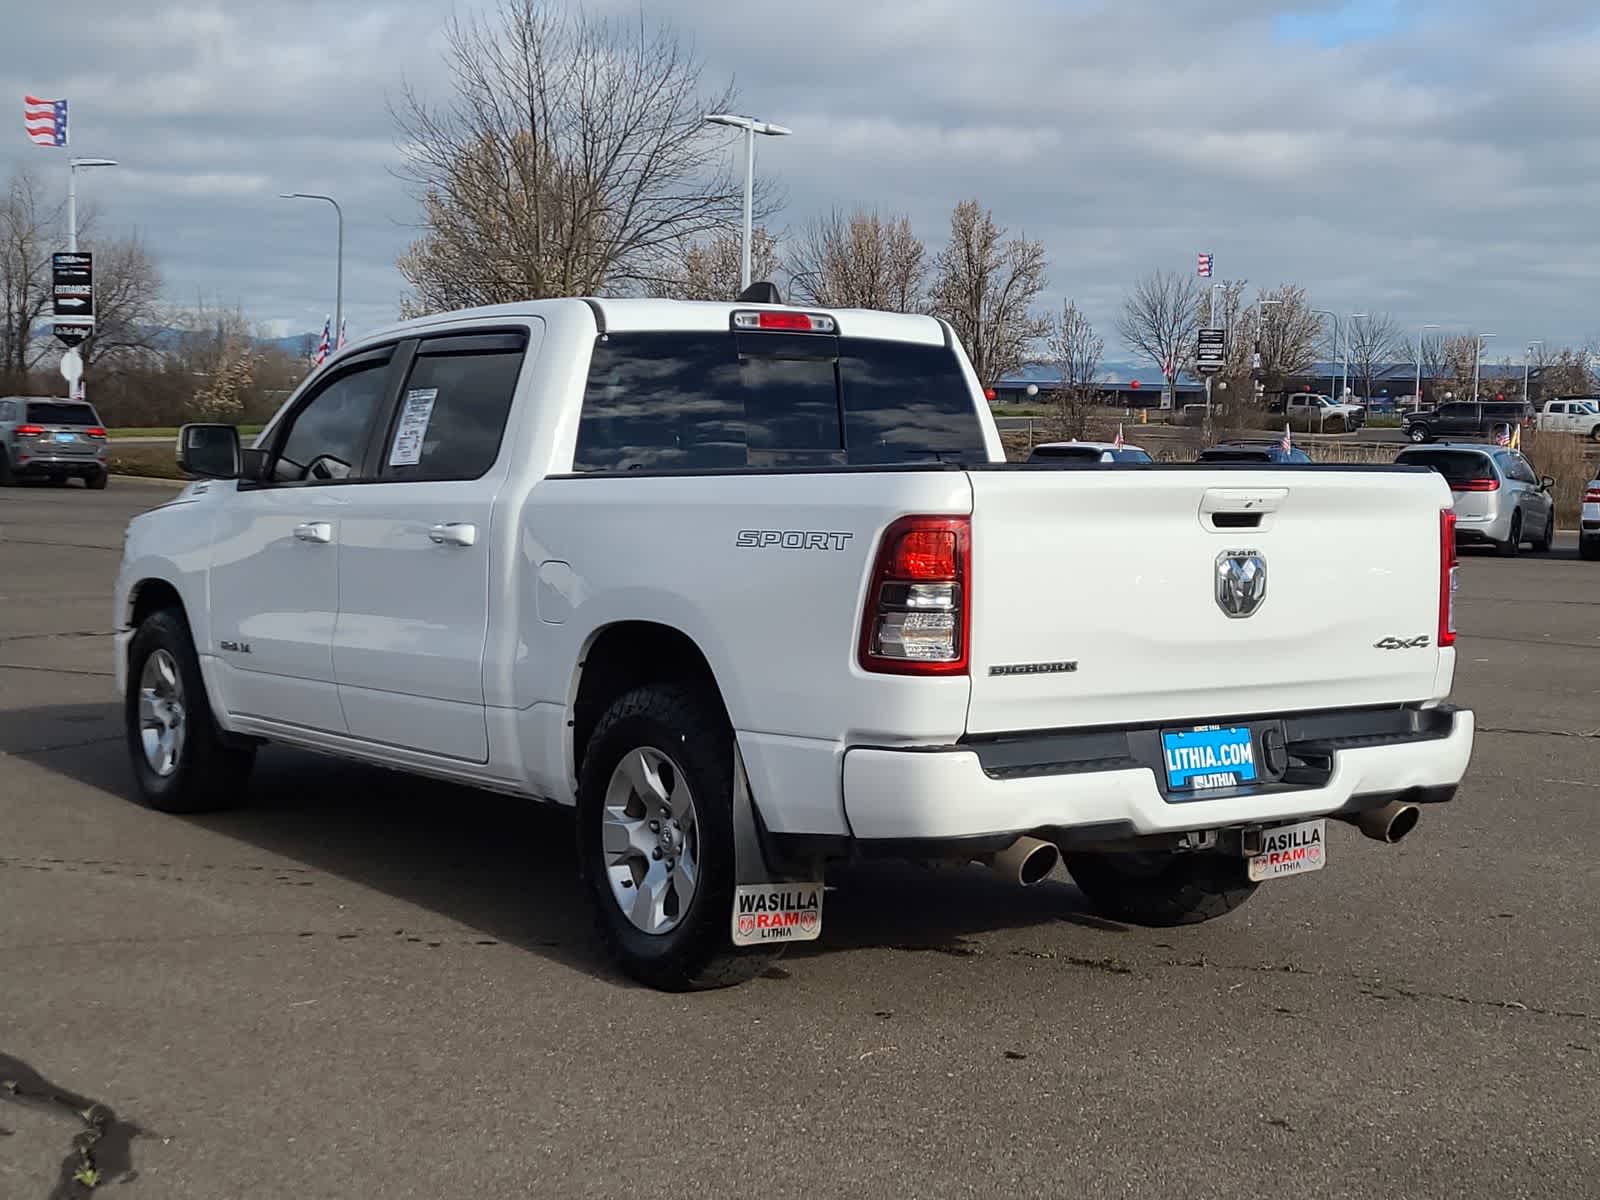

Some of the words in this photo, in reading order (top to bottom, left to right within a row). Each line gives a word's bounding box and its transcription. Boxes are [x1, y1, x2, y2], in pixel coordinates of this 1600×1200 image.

[736, 530, 853, 550] SPORT
[1167, 742, 1253, 771] LITHIA.COM
[1203, 772, 1237, 788] LITHIA
[1270, 847, 1306, 865] RAM
[1274, 861, 1302, 873] LITHIA
[739, 891, 818, 913] WASILLA
[757, 911, 800, 928] RAM
[761, 927, 792, 938] LITHIA
